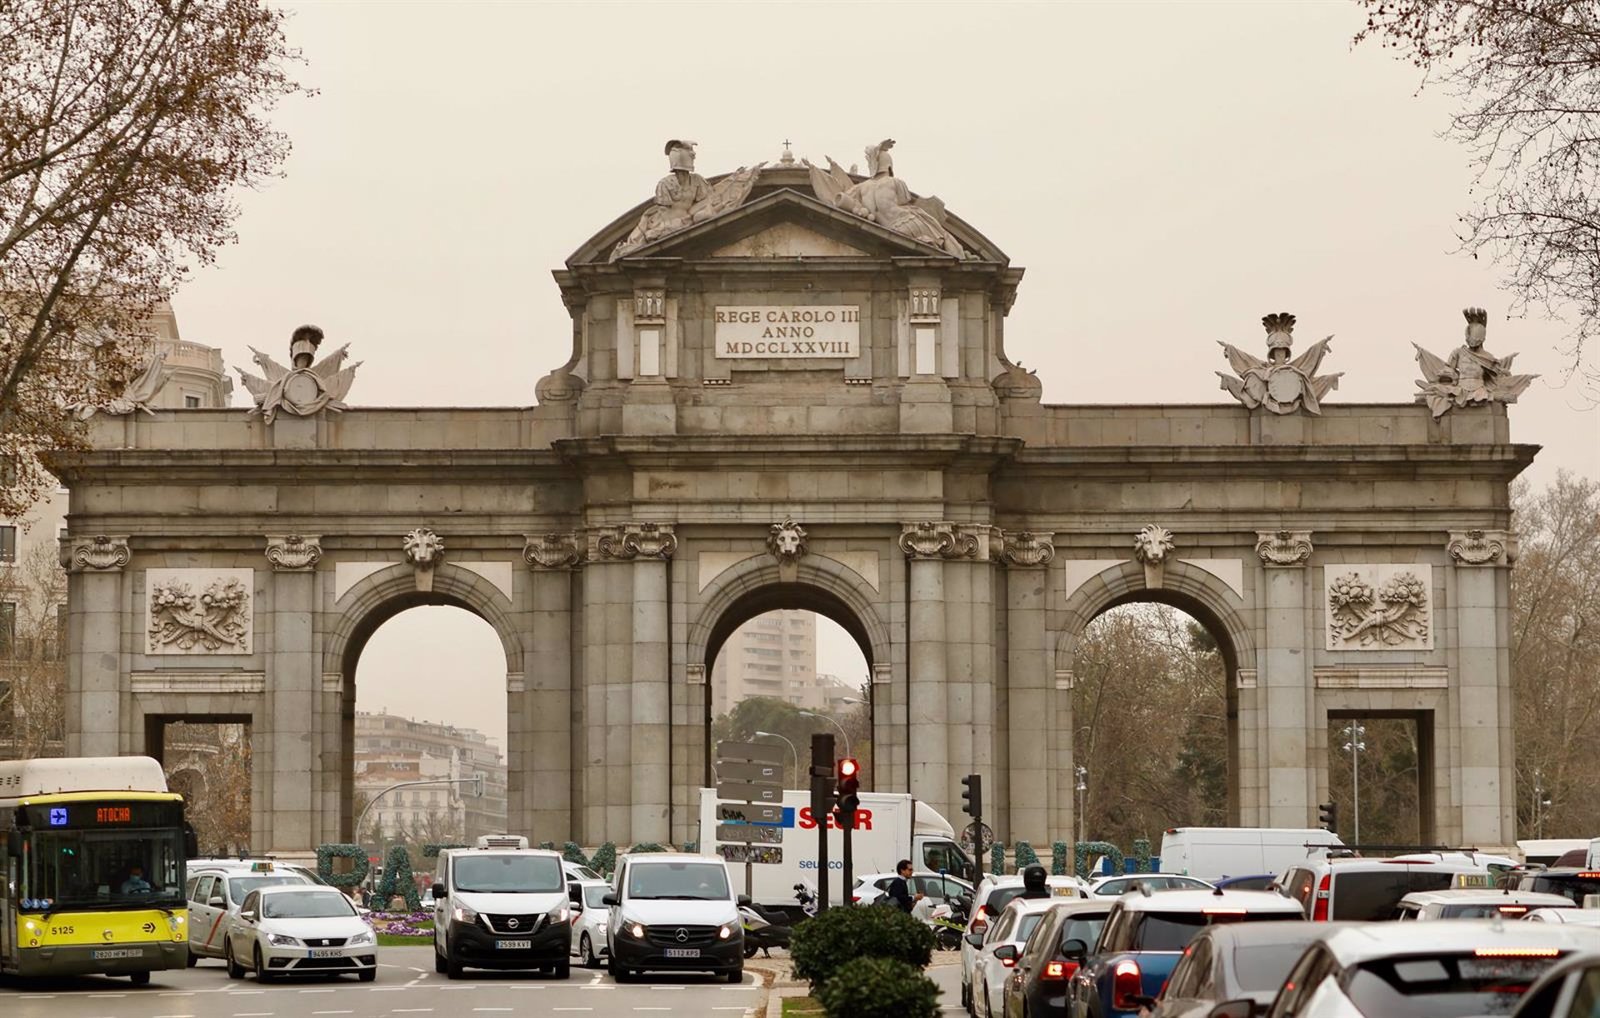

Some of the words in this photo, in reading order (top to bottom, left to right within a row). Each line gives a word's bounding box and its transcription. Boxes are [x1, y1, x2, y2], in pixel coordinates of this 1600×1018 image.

[716, 311, 761, 323] REGE
[766, 310, 836, 323] CAROLO
[841, 310, 860, 322] III
[762, 326, 814, 338] ANNO
[726, 341, 850, 354] MDCCLXXVIII
[96, 807, 131, 822] ATOCHA
[1468, 876, 1486, 886] TAXI
[51, 925, 74, 935] 5125
[668, 949, 685, 957] 5112
